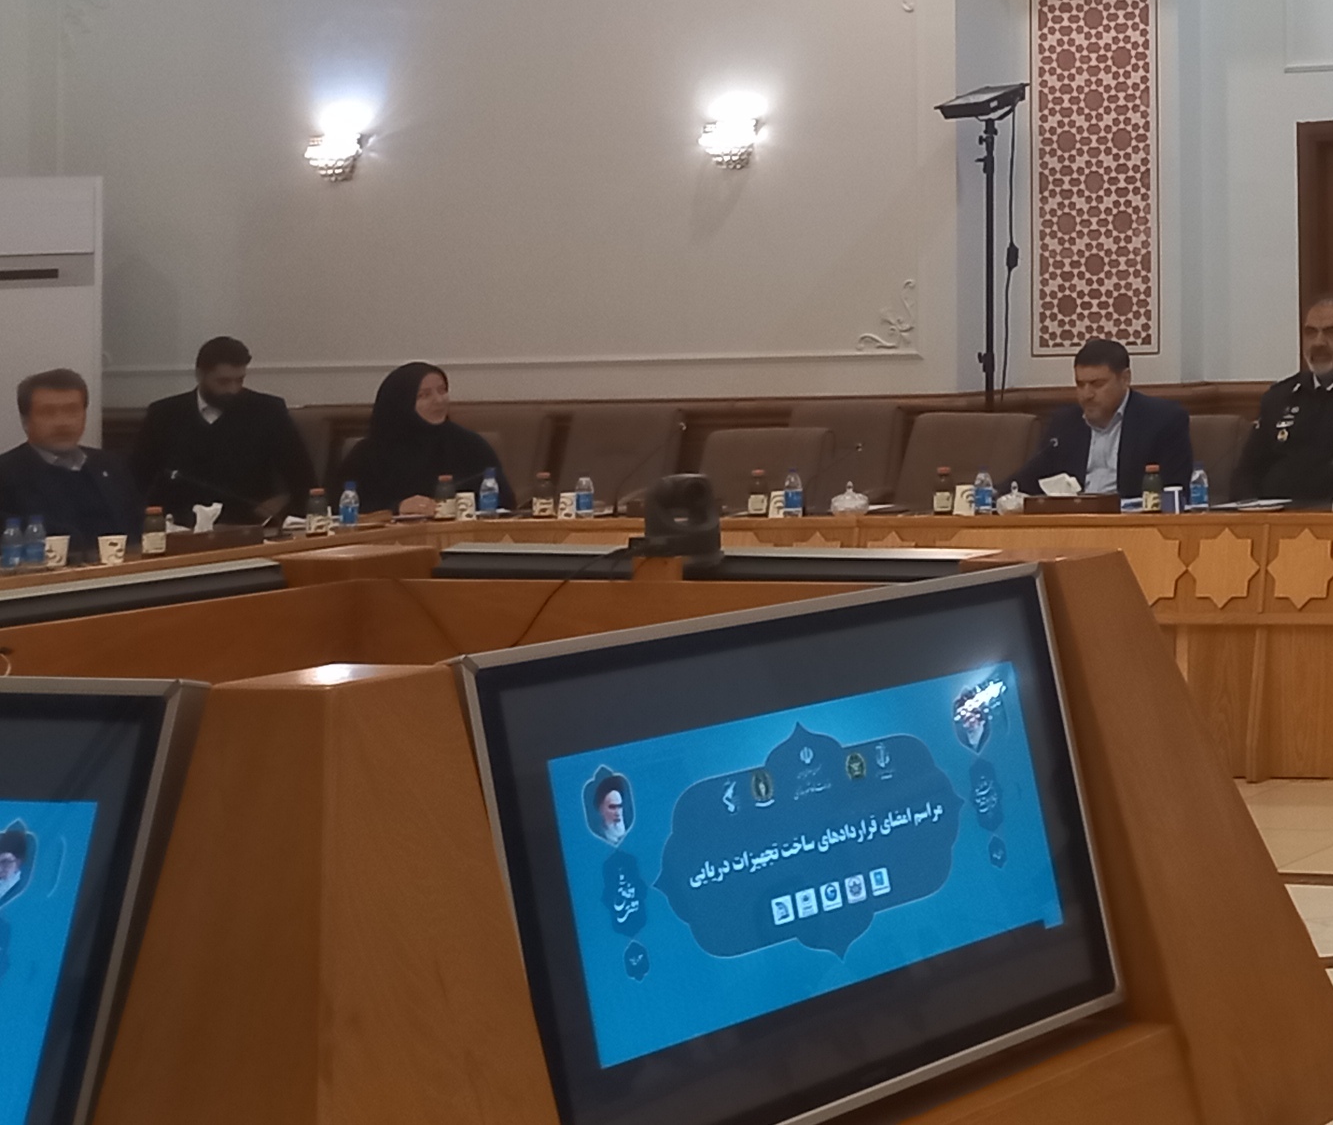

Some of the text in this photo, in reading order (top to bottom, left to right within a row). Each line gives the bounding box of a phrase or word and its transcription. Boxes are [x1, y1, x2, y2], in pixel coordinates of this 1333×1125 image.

[689, 801, 944, 888] مراسم امضای قراردادهای ساخت تجهیزات دریایی
